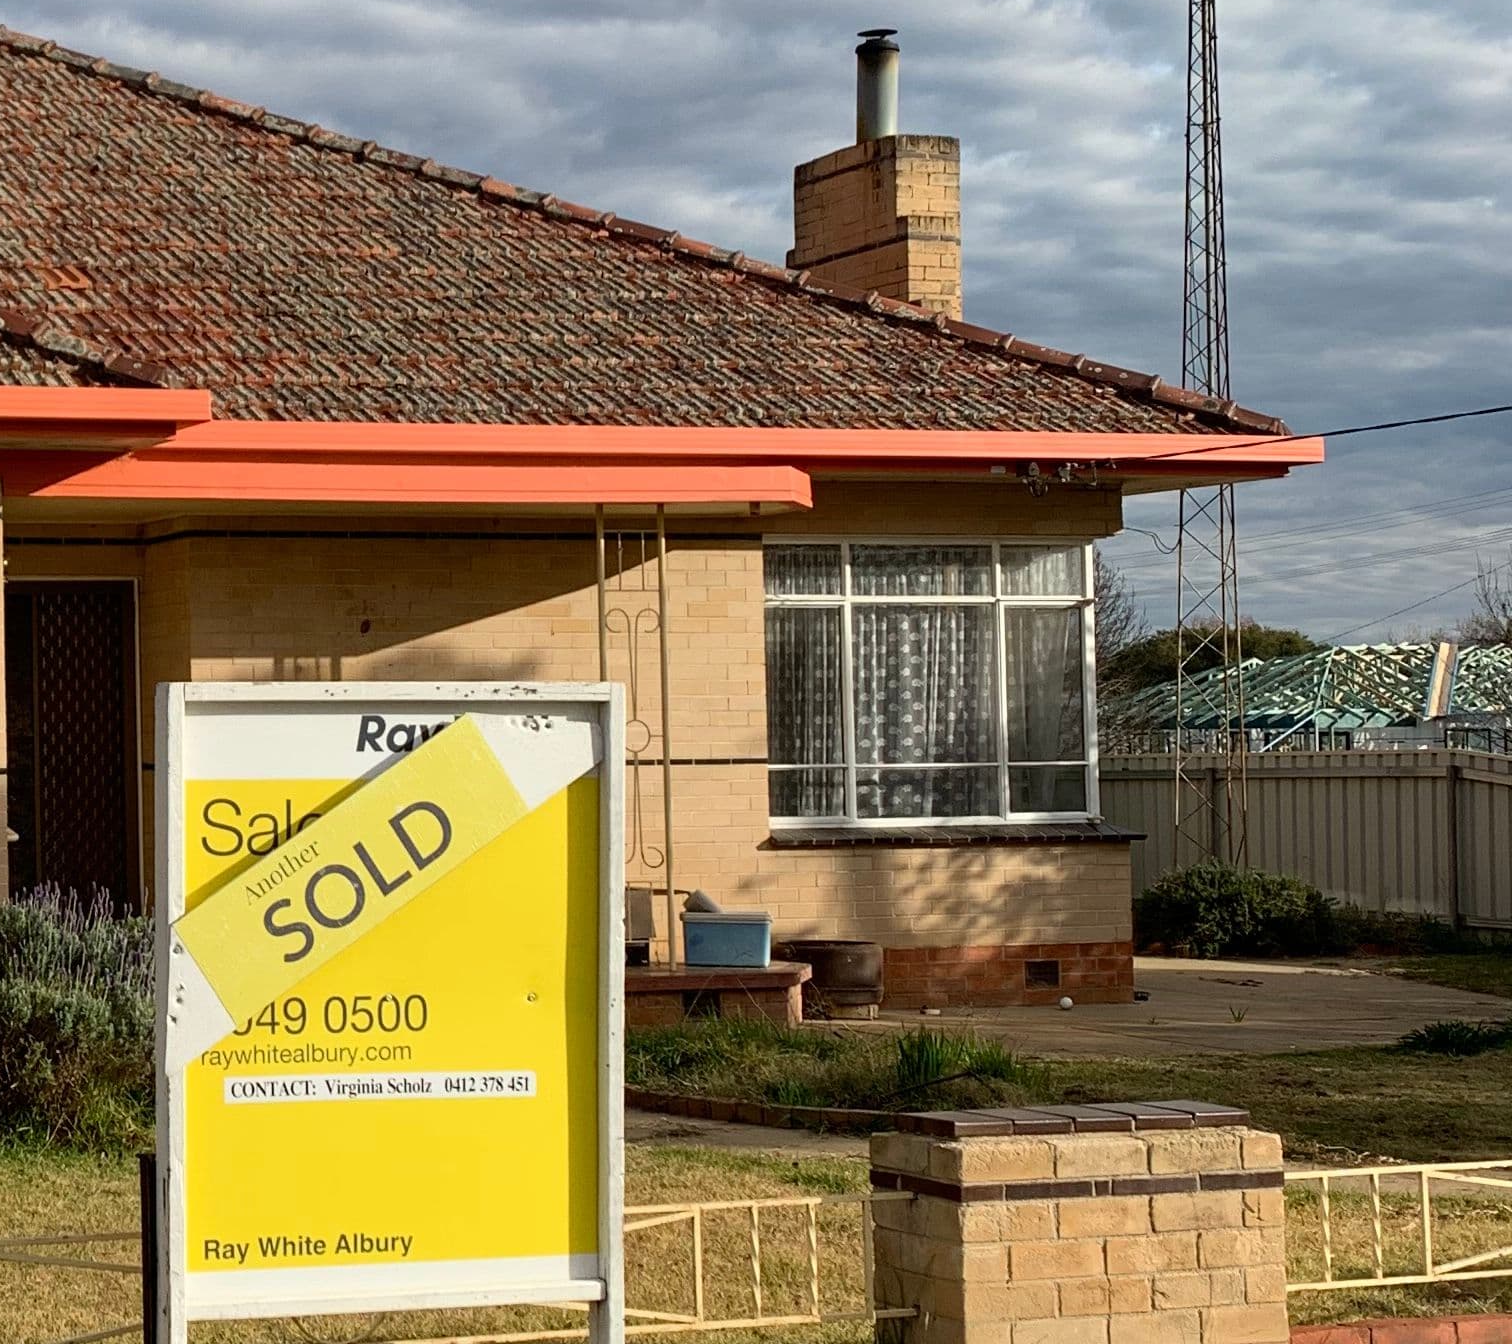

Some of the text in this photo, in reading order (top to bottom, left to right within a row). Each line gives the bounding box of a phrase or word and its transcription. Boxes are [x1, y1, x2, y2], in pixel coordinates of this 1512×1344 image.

[244, 840, 320, 906] Another
[263, 801, 452, 963] SOLD
[324, 994, 427, 1033] 0500
[201, 1043, 412, 1070] raywhitealbury.com
[231, 1076, 529, 1098] CONTACT: Virginia Scholz 0412 378 451
[204, 1232, 413, 1263] Ray White Albury
